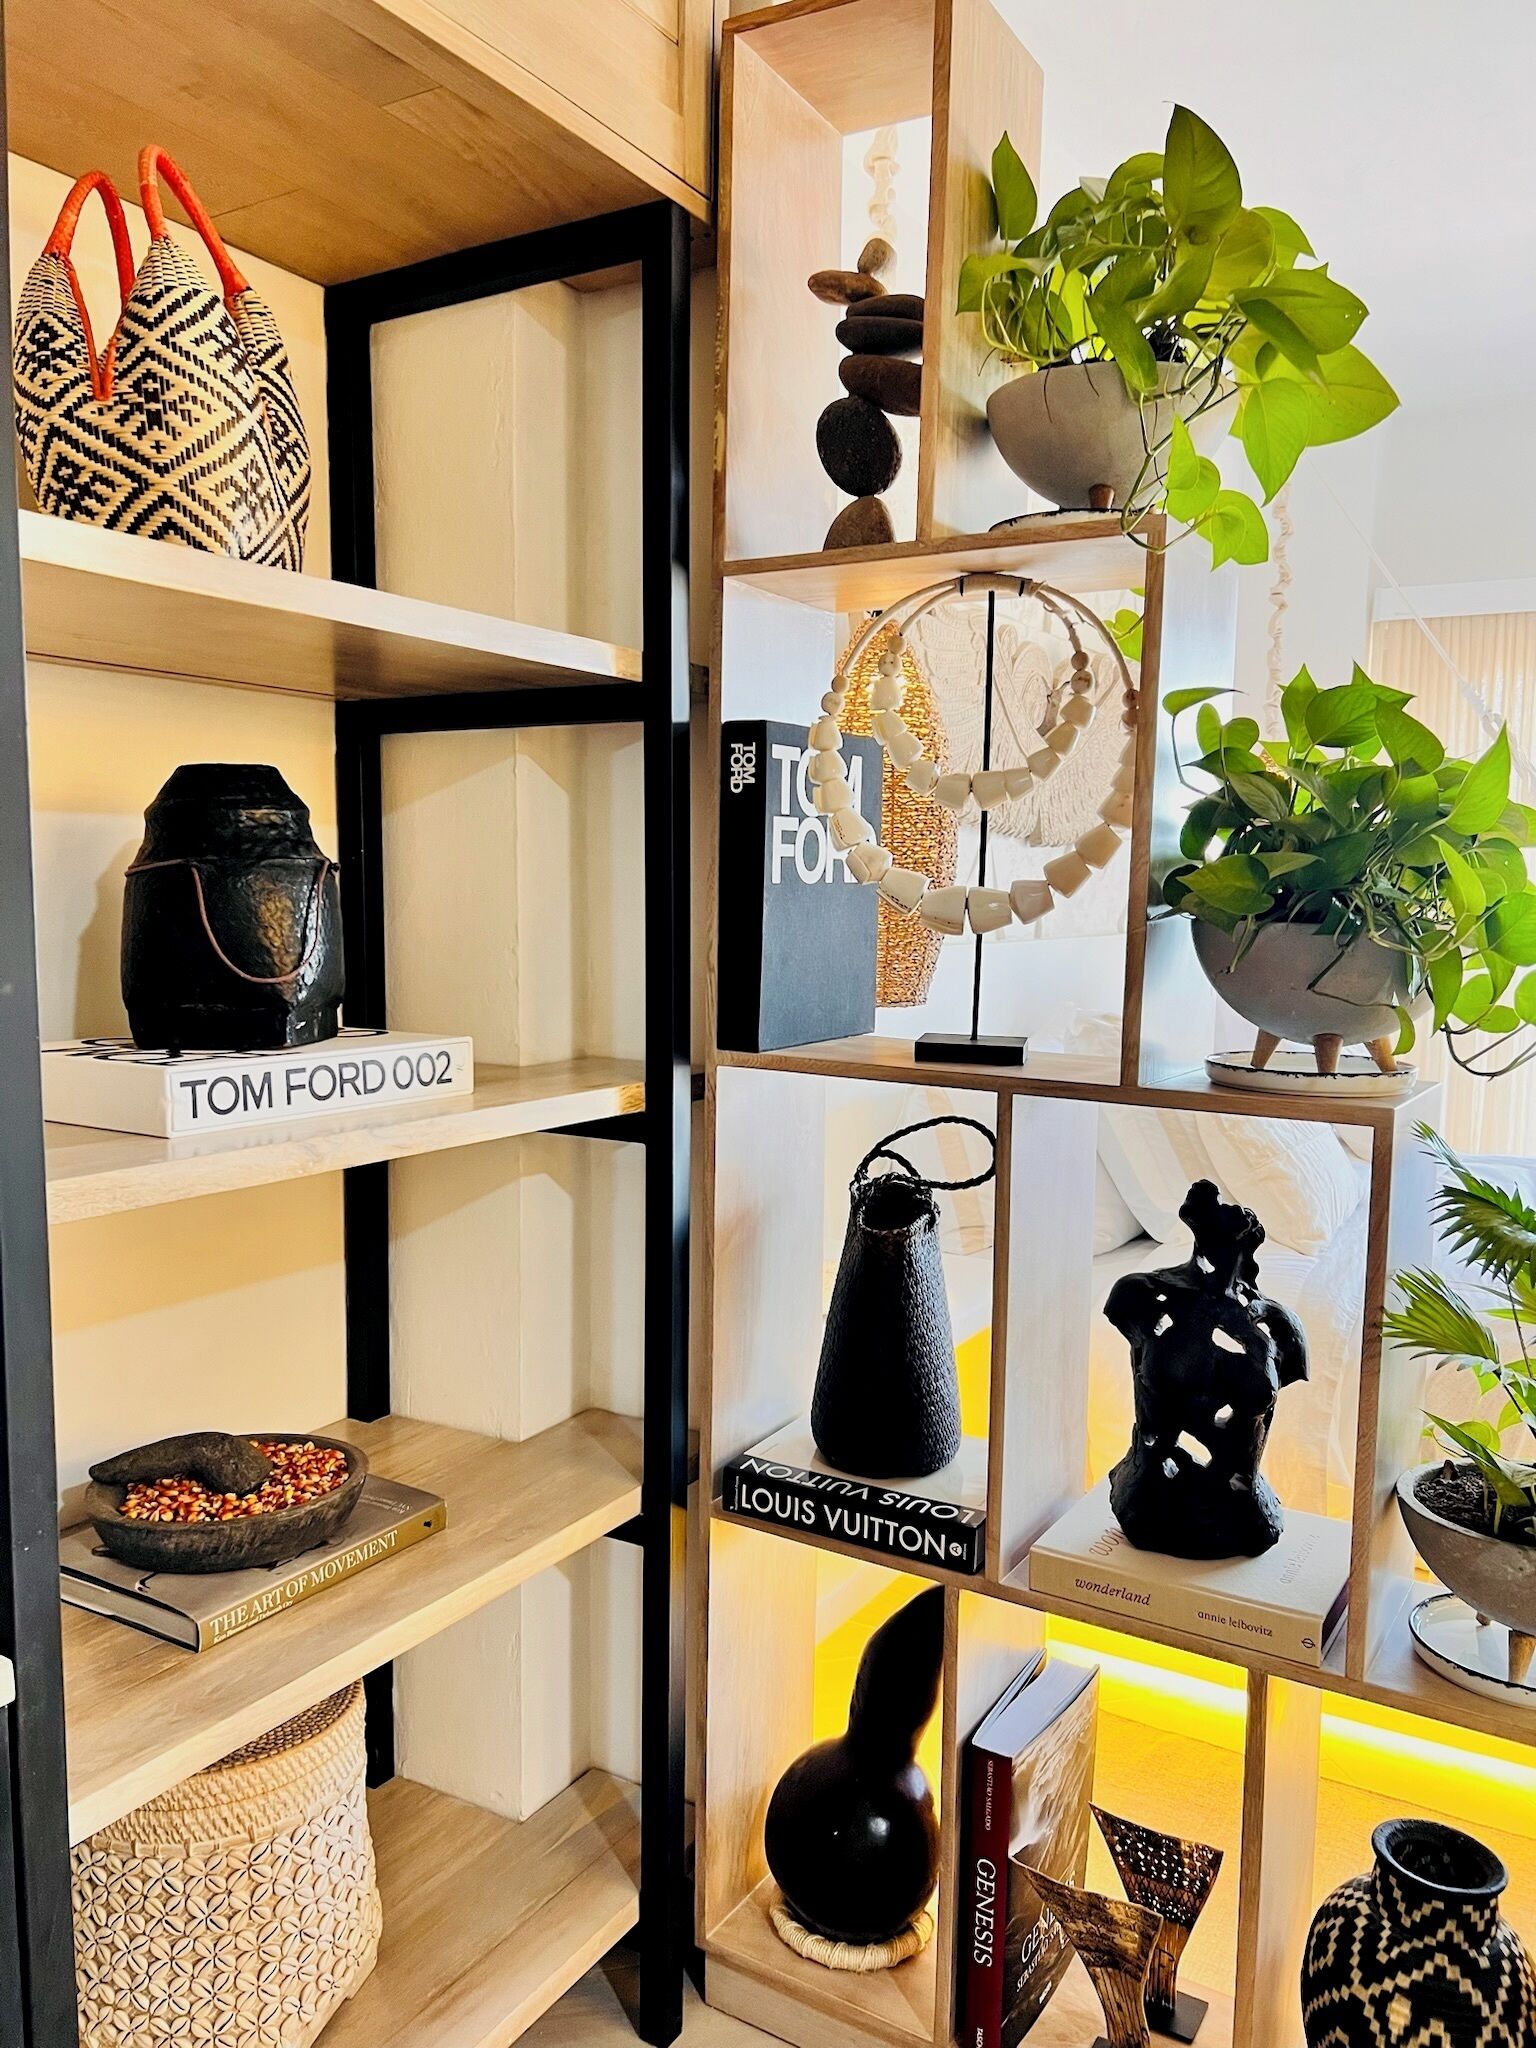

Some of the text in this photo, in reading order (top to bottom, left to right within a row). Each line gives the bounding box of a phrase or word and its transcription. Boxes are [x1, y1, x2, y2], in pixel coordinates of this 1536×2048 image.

[731, 743, 743, 794] FORD
[742, 742, 756, 784] TOM
[771, 816, 877, 885] FOR
[180, 1050, 453, 1119] TOM FORD 002
[739, 1458, 869, 1500] VUITTON
[741, 1483, 816, 1525] LOUIS
[823, 1504, 946, 1561] VUITTON
[878, 1492, 976, 1524] LOUIS
[210, 1529, 399, 1636] THE ART OF MOVEMENT
[1074, 1577, 1152, 1606] wonderland
[1197, 1610, 1273, 1637] annie leibovitz
[973, 1858, 997, 1968] GENESIS
